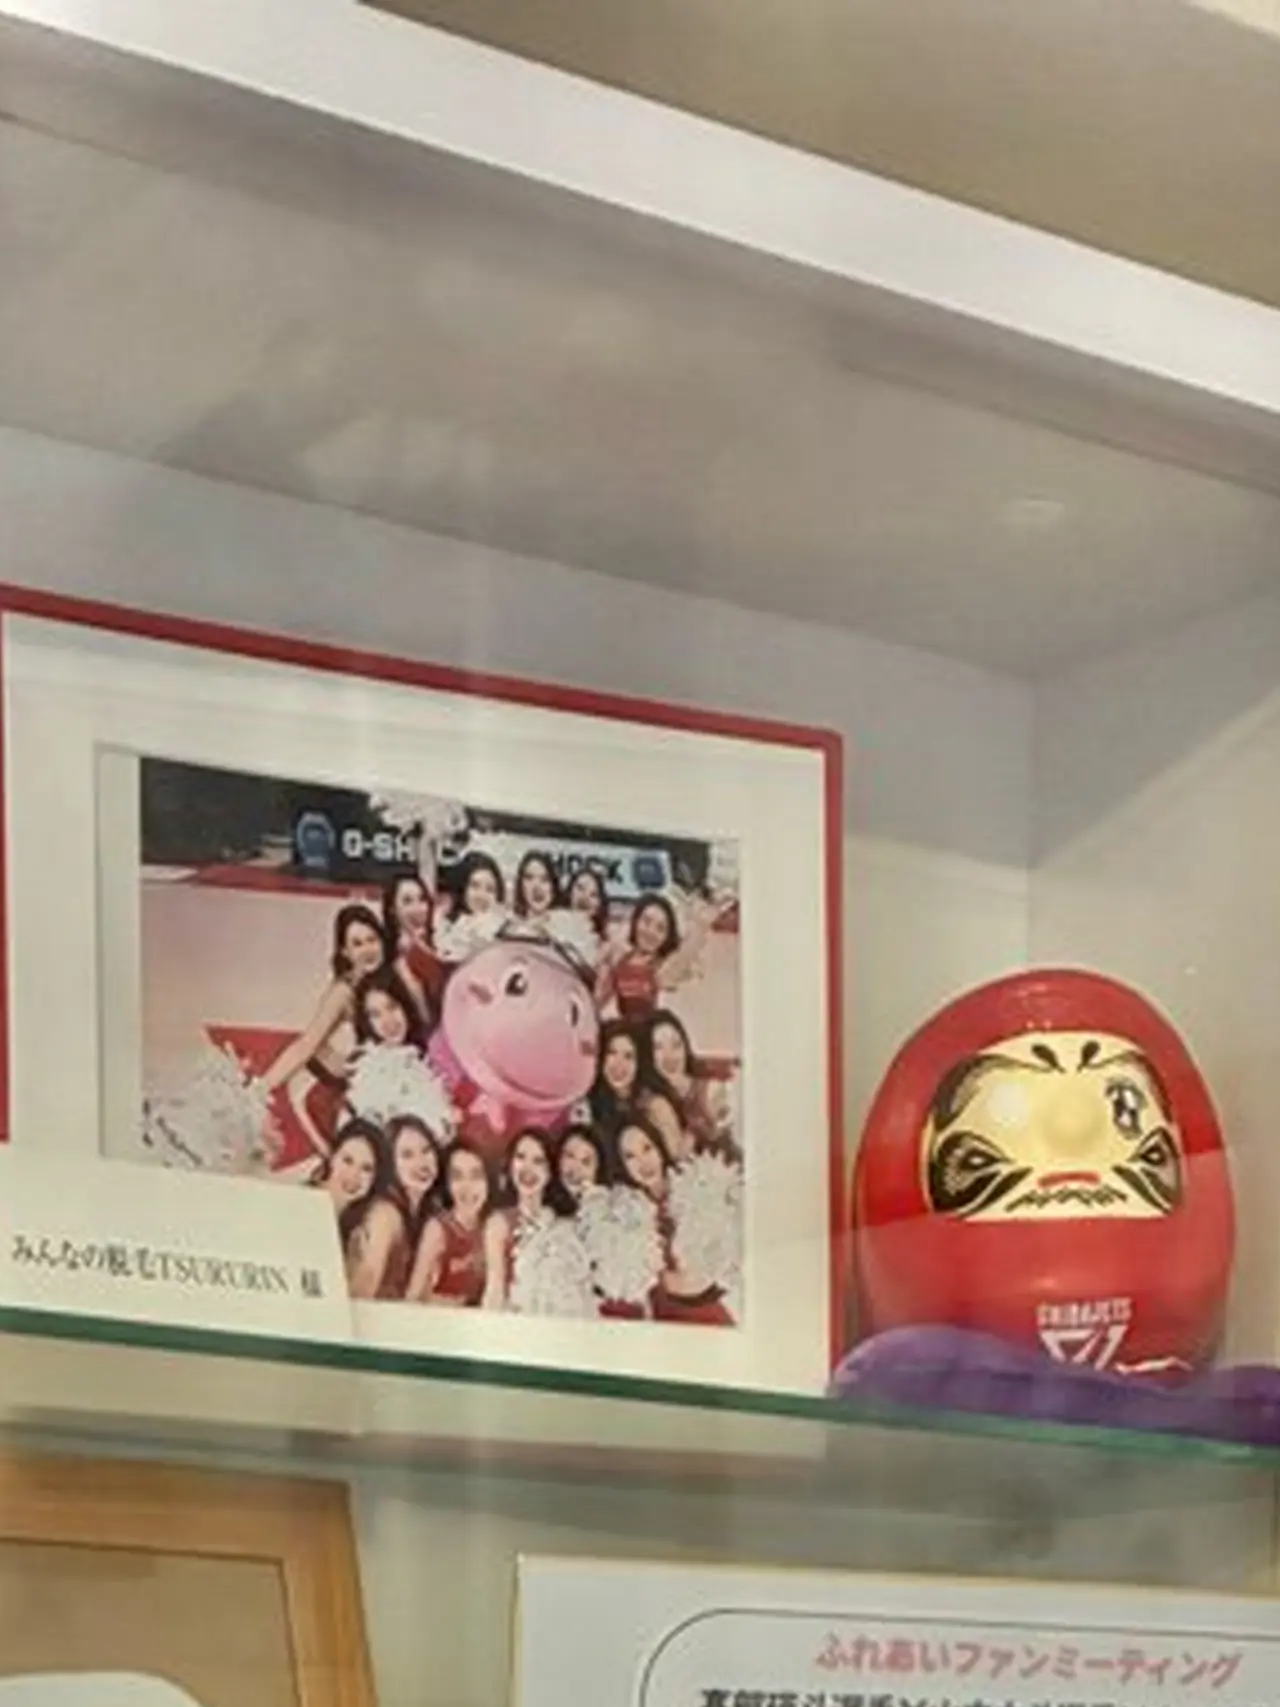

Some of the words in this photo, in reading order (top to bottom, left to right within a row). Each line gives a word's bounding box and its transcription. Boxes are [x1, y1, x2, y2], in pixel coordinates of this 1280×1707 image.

[816, 1631, 1242, 1688] ふれあいファンミーティング
